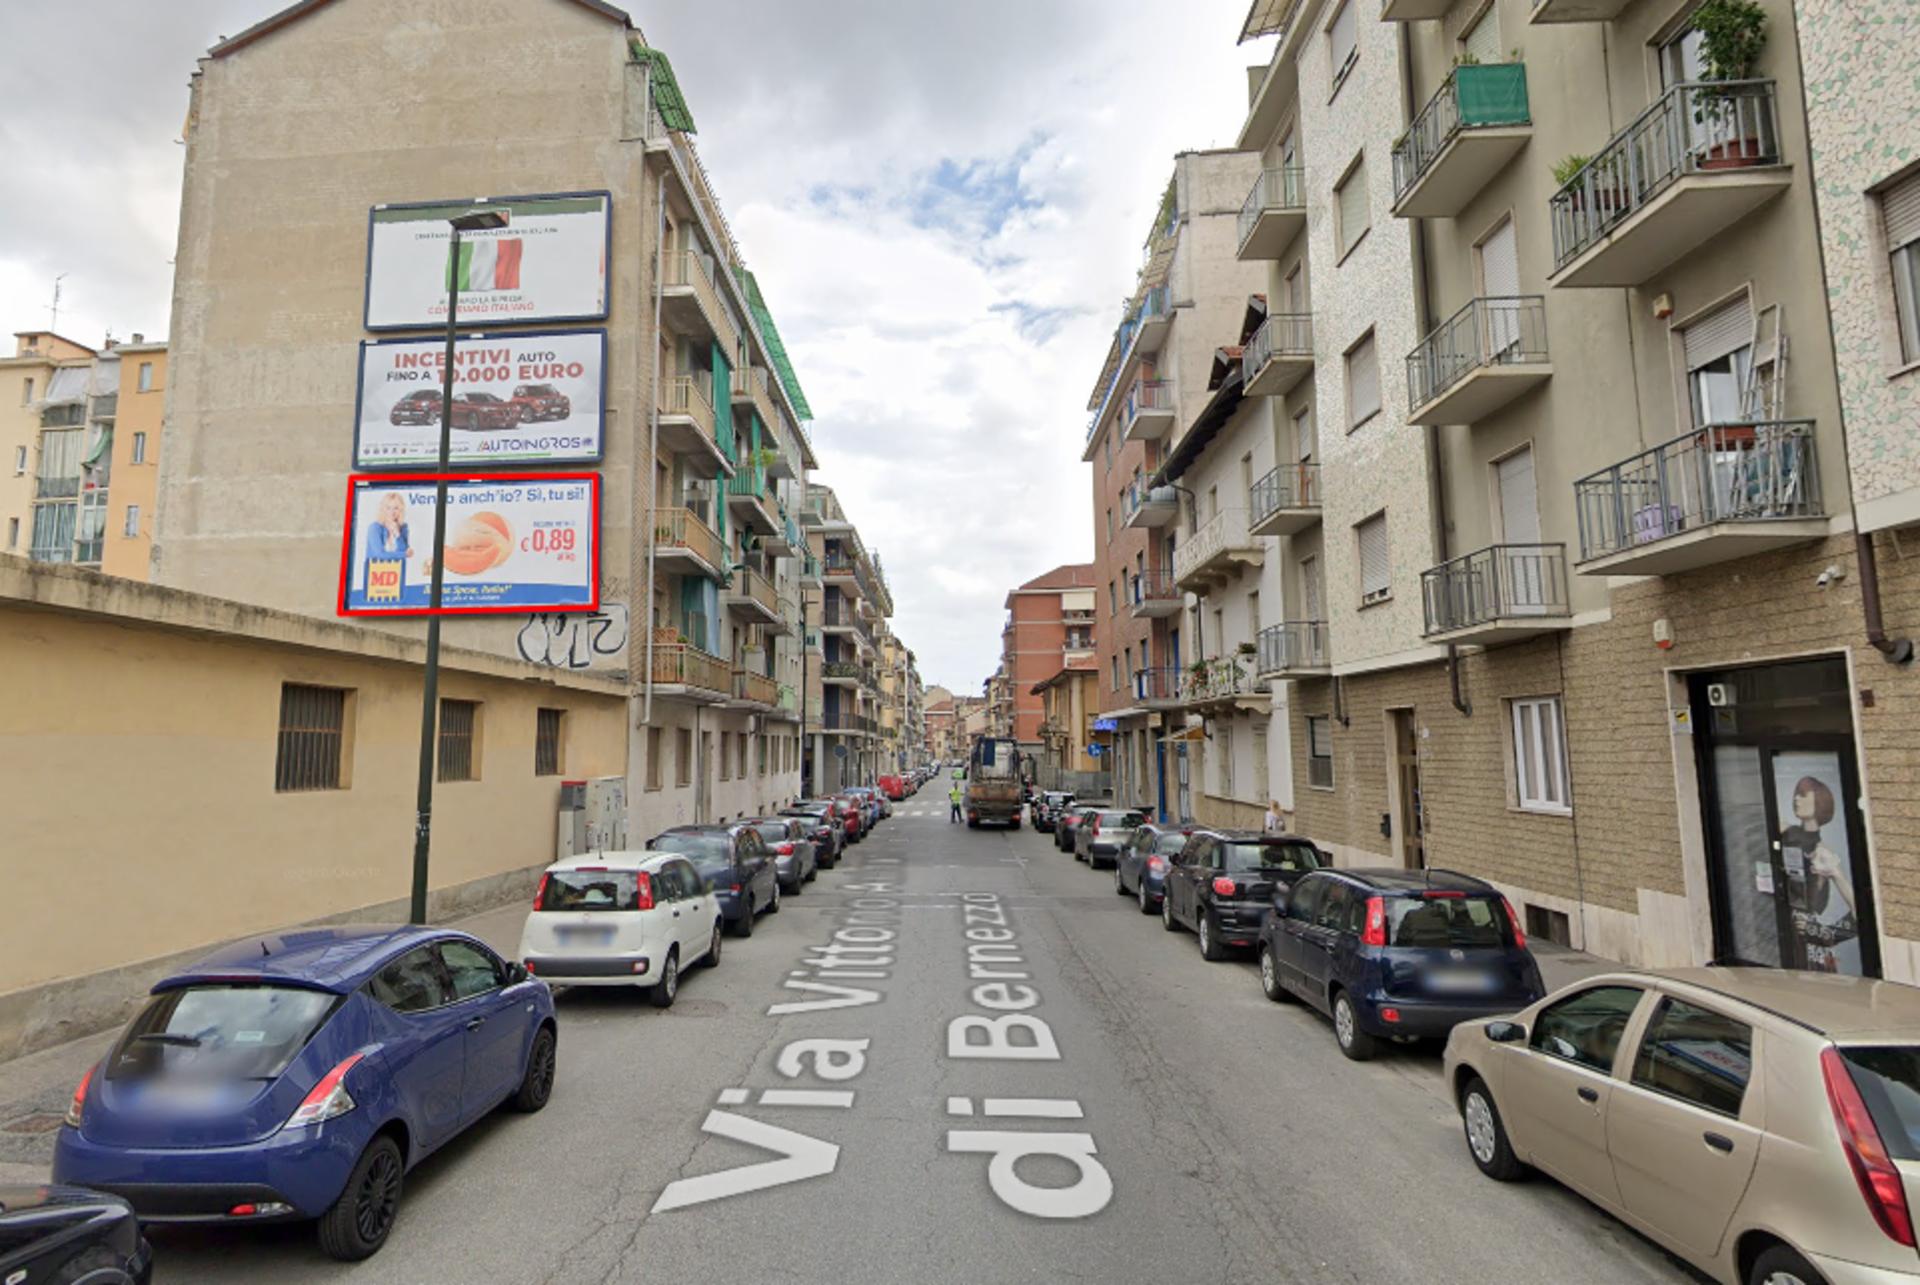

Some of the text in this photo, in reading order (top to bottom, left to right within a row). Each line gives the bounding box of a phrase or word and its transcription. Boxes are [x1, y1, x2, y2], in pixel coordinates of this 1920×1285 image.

[394, 349, 556, 369] INCENTIVI AUTO
[386, 370, 419, 382] FINO
[420, 371, 432, 381] A
[518, 362, 585, 381] EURO
[409, 491, 454, 506] Veno
[549, 488, 565, 501] tu
[371, 571, 399, 586] MD
